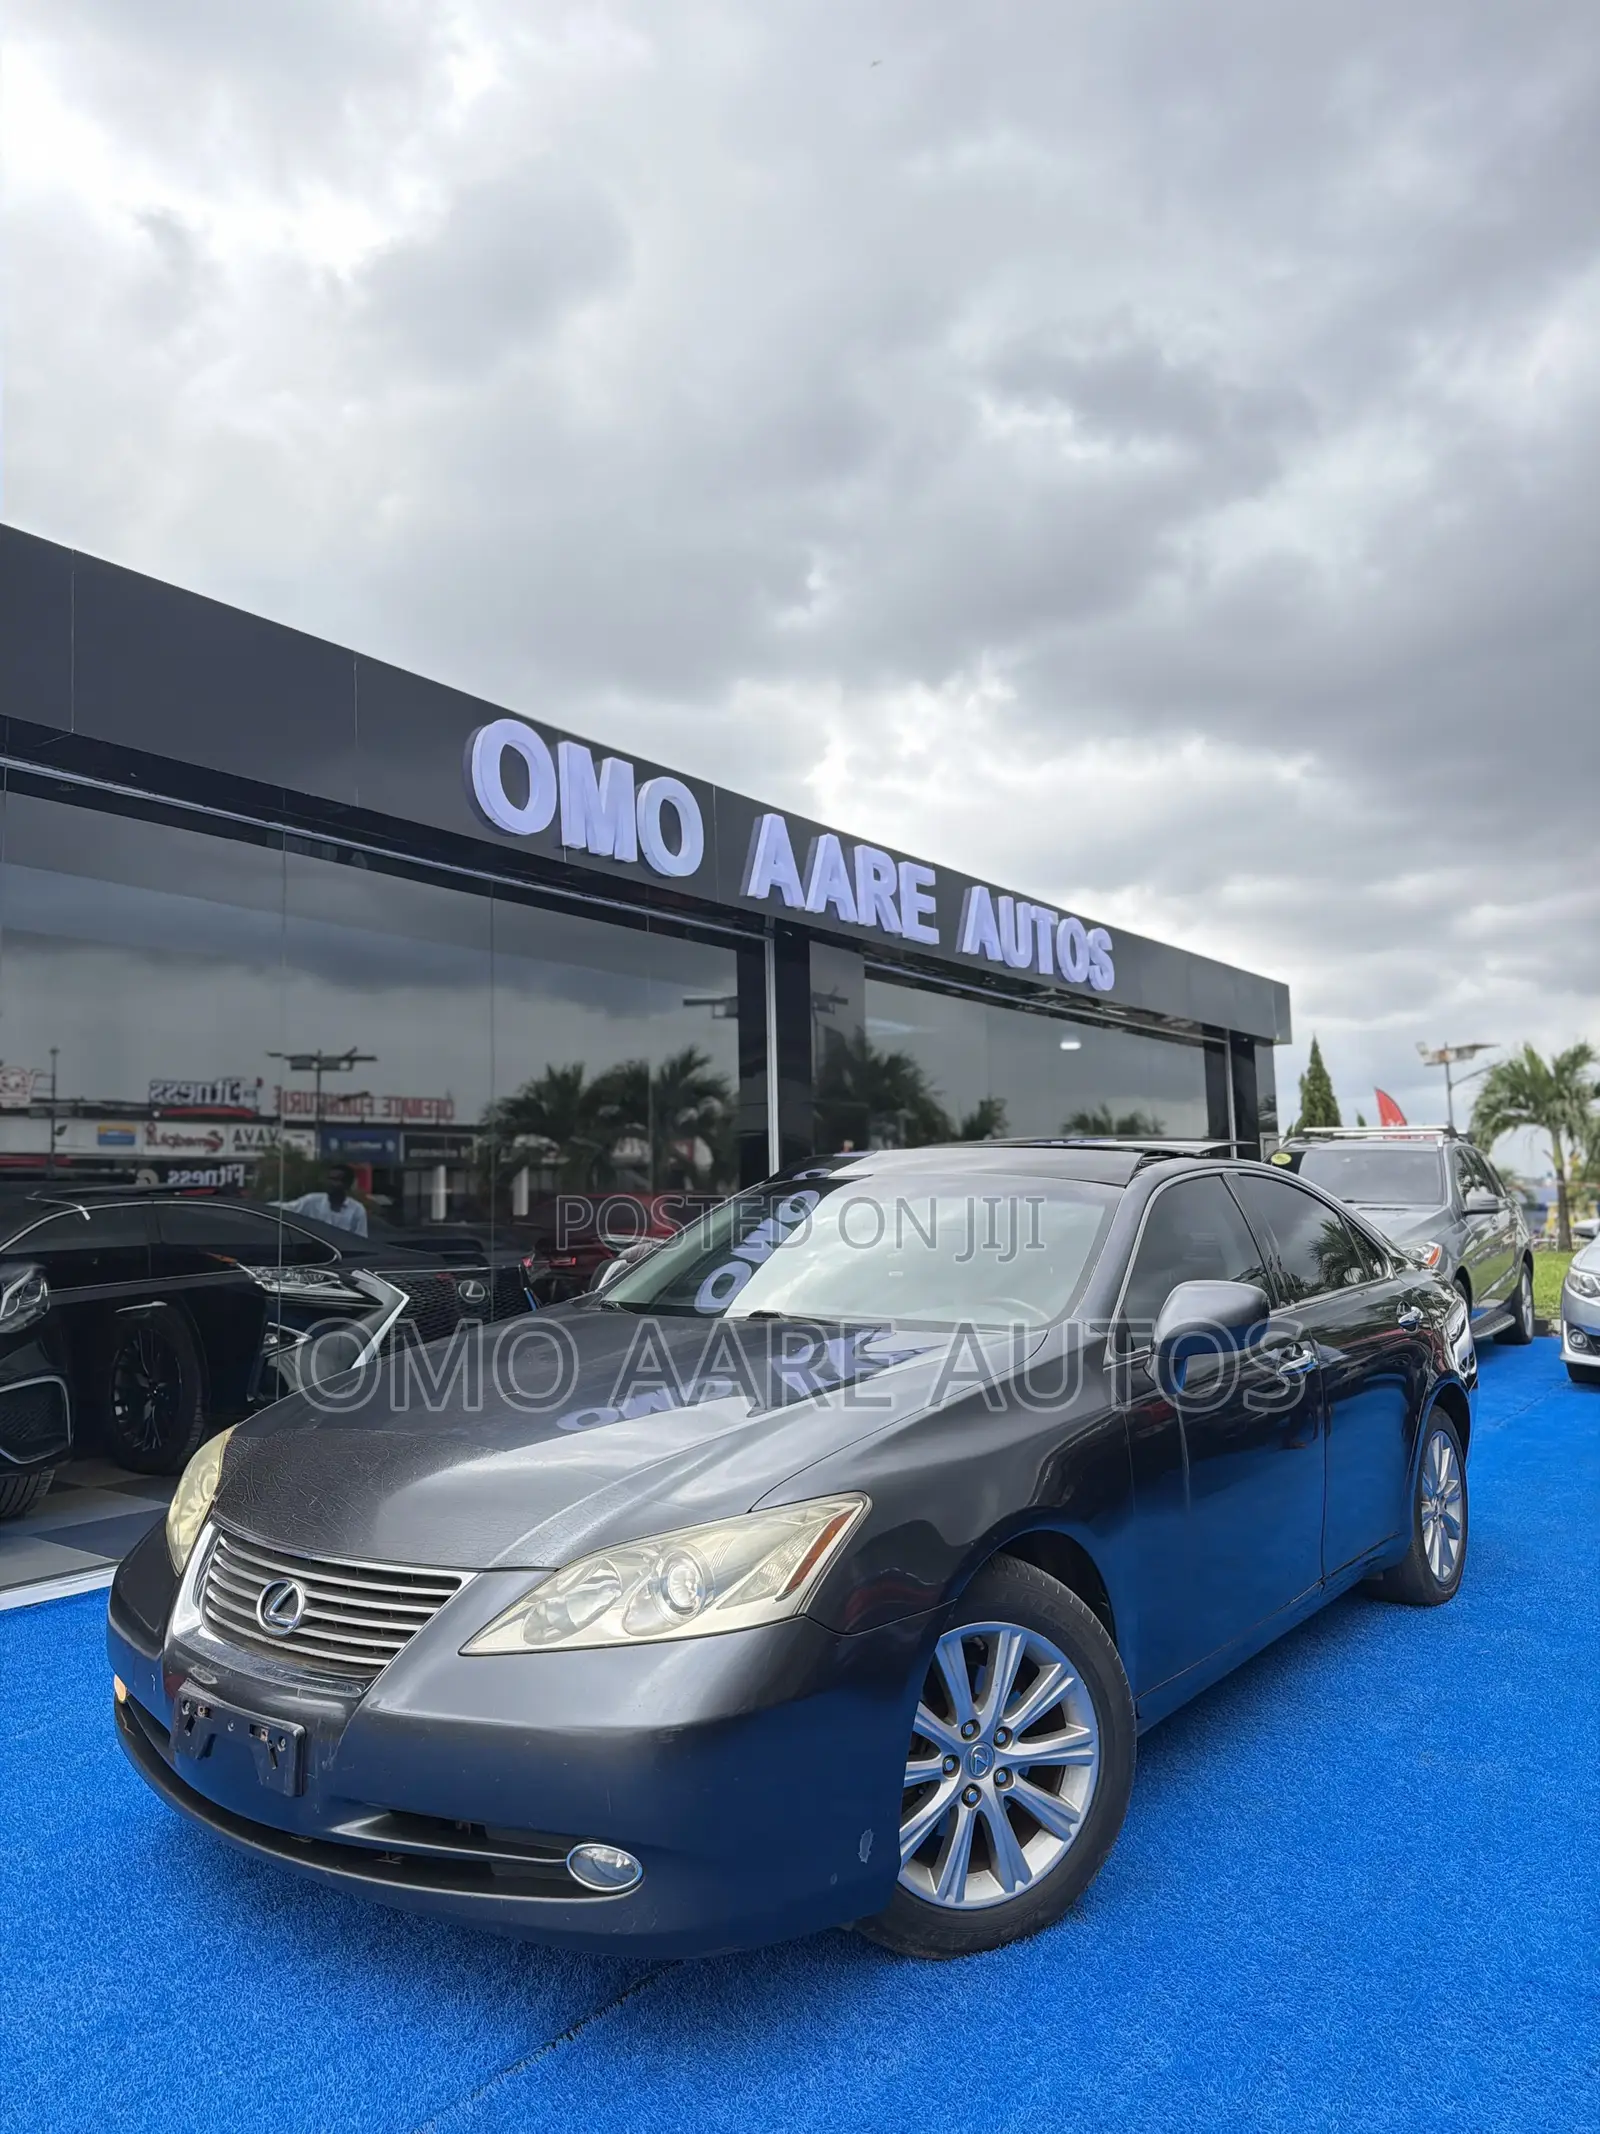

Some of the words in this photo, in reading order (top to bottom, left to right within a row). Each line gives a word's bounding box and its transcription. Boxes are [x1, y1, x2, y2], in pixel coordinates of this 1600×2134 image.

[466, 718, 704, 878] OMO
[743, 813, 940, 945] AARE
[957, 885, 1115, 992] AUTOS
